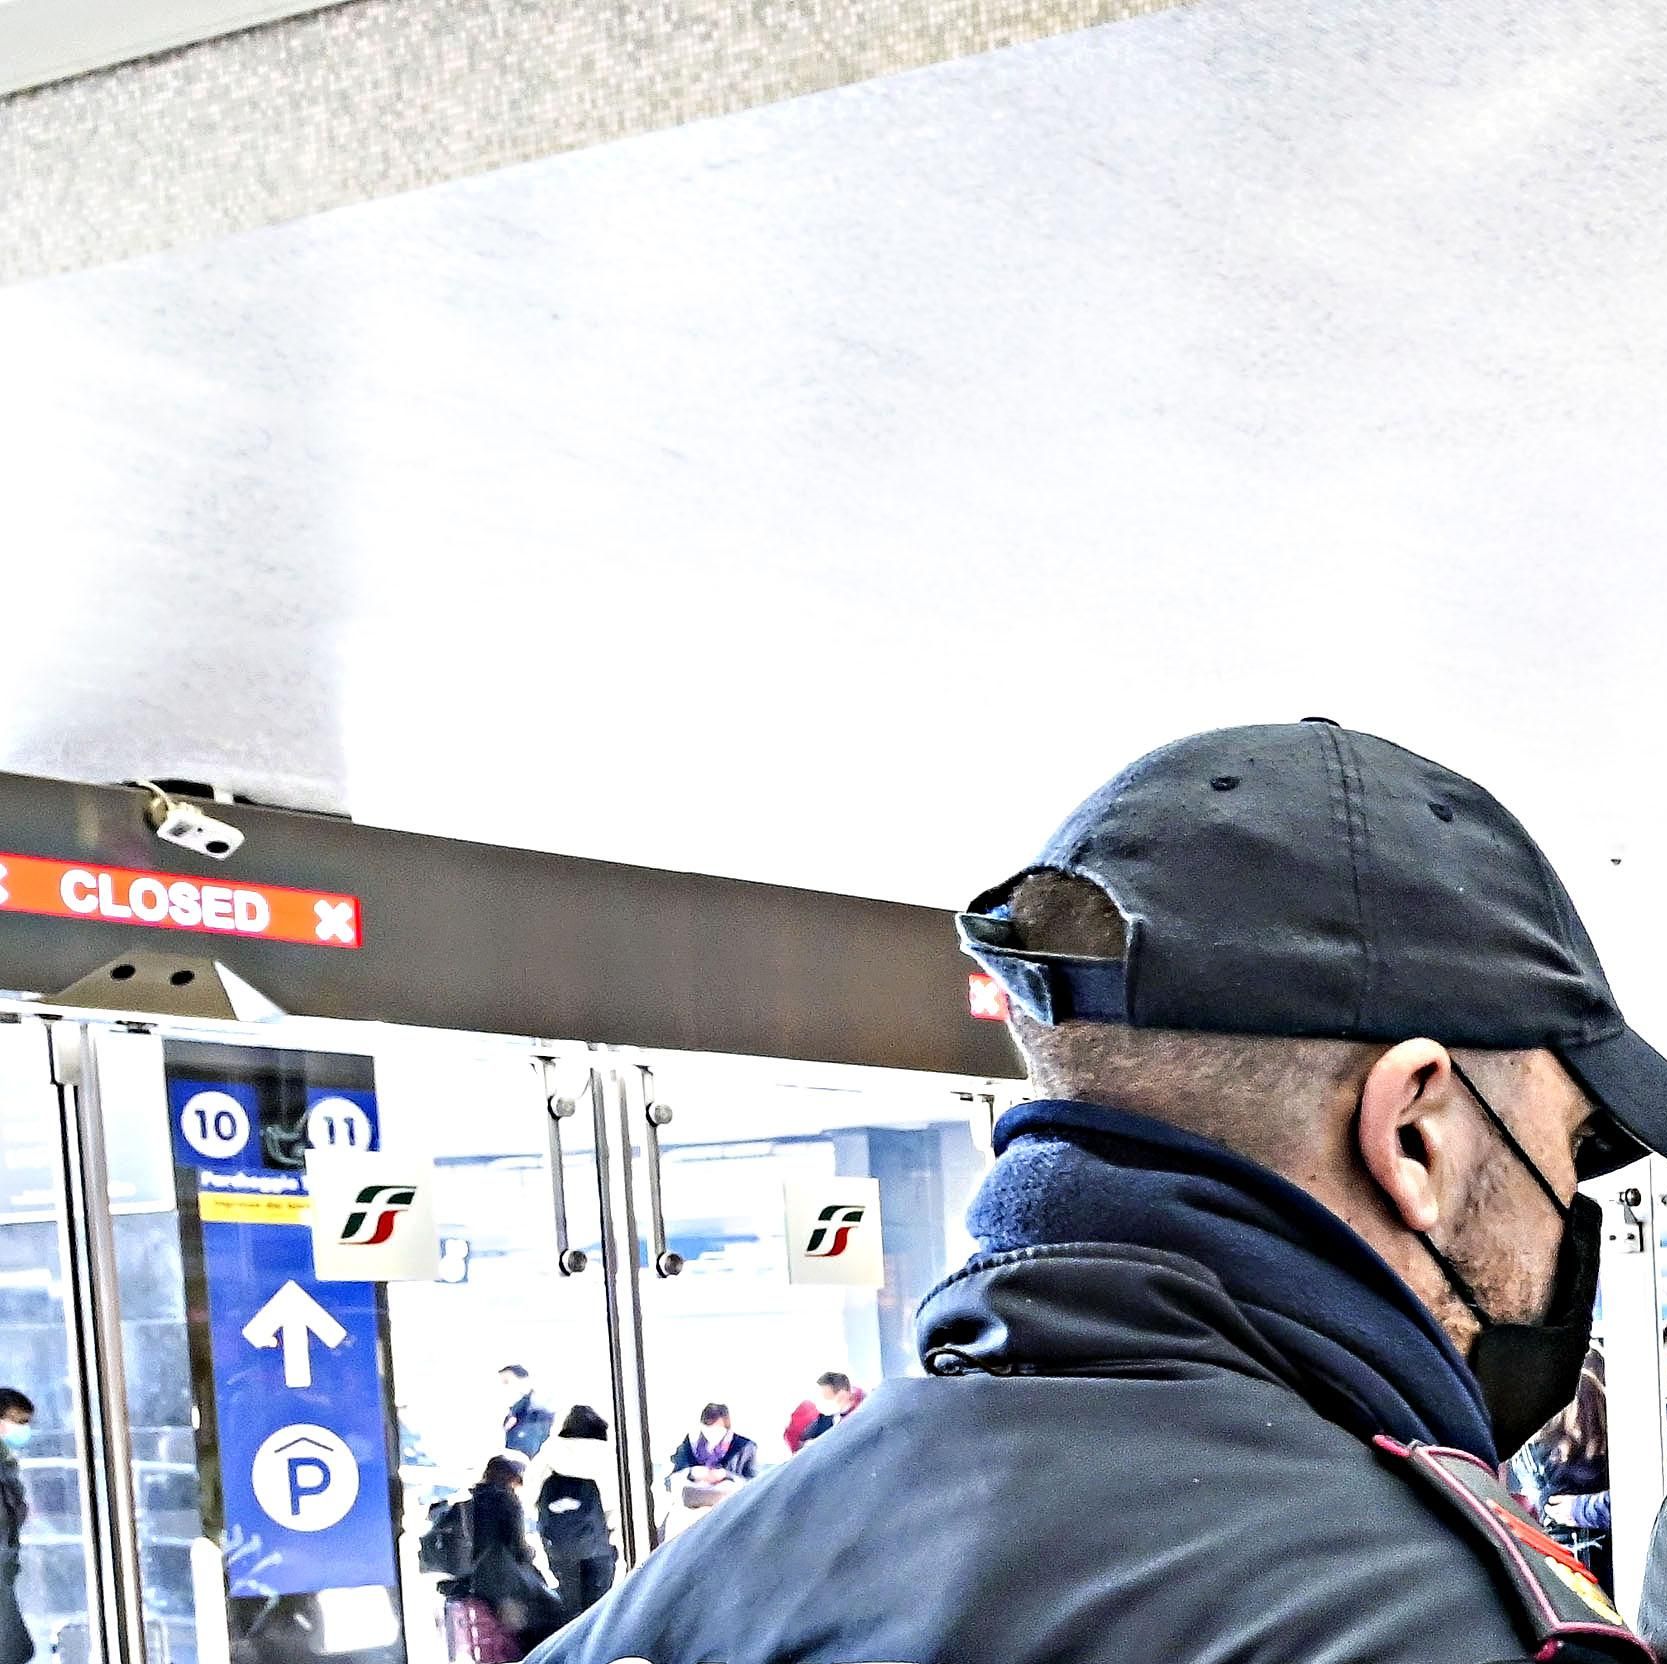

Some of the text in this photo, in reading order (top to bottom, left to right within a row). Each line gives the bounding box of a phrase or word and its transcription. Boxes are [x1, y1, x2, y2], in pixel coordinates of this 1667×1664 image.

[60, 868, 270, 933] CLOSED
[194, 1109, 356, 1146] 10 11
